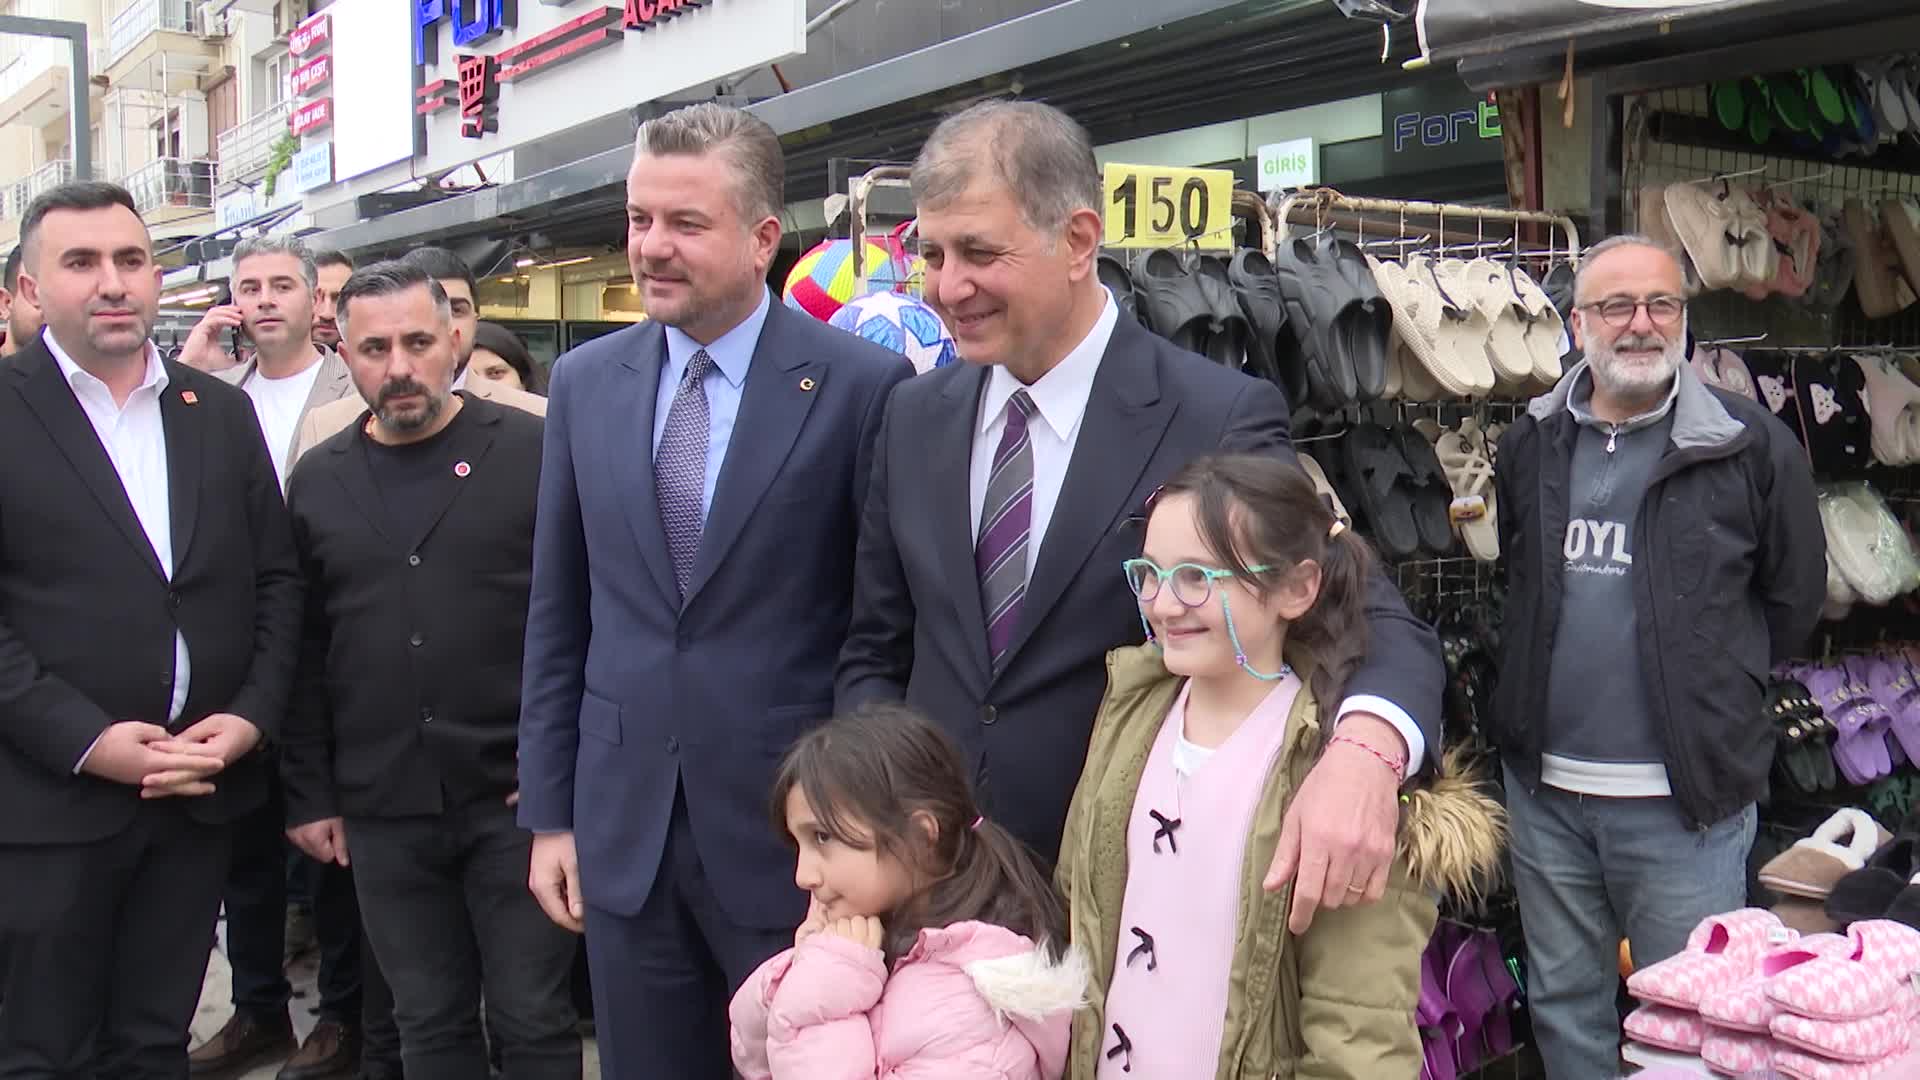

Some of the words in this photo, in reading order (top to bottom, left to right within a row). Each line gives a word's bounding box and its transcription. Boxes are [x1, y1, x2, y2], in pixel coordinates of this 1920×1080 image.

[1263, 152, 1307, 175] GİRİŞ
[1113, 174, 1209, 239] 150
[1563, 518, 1632, 564] OYL
